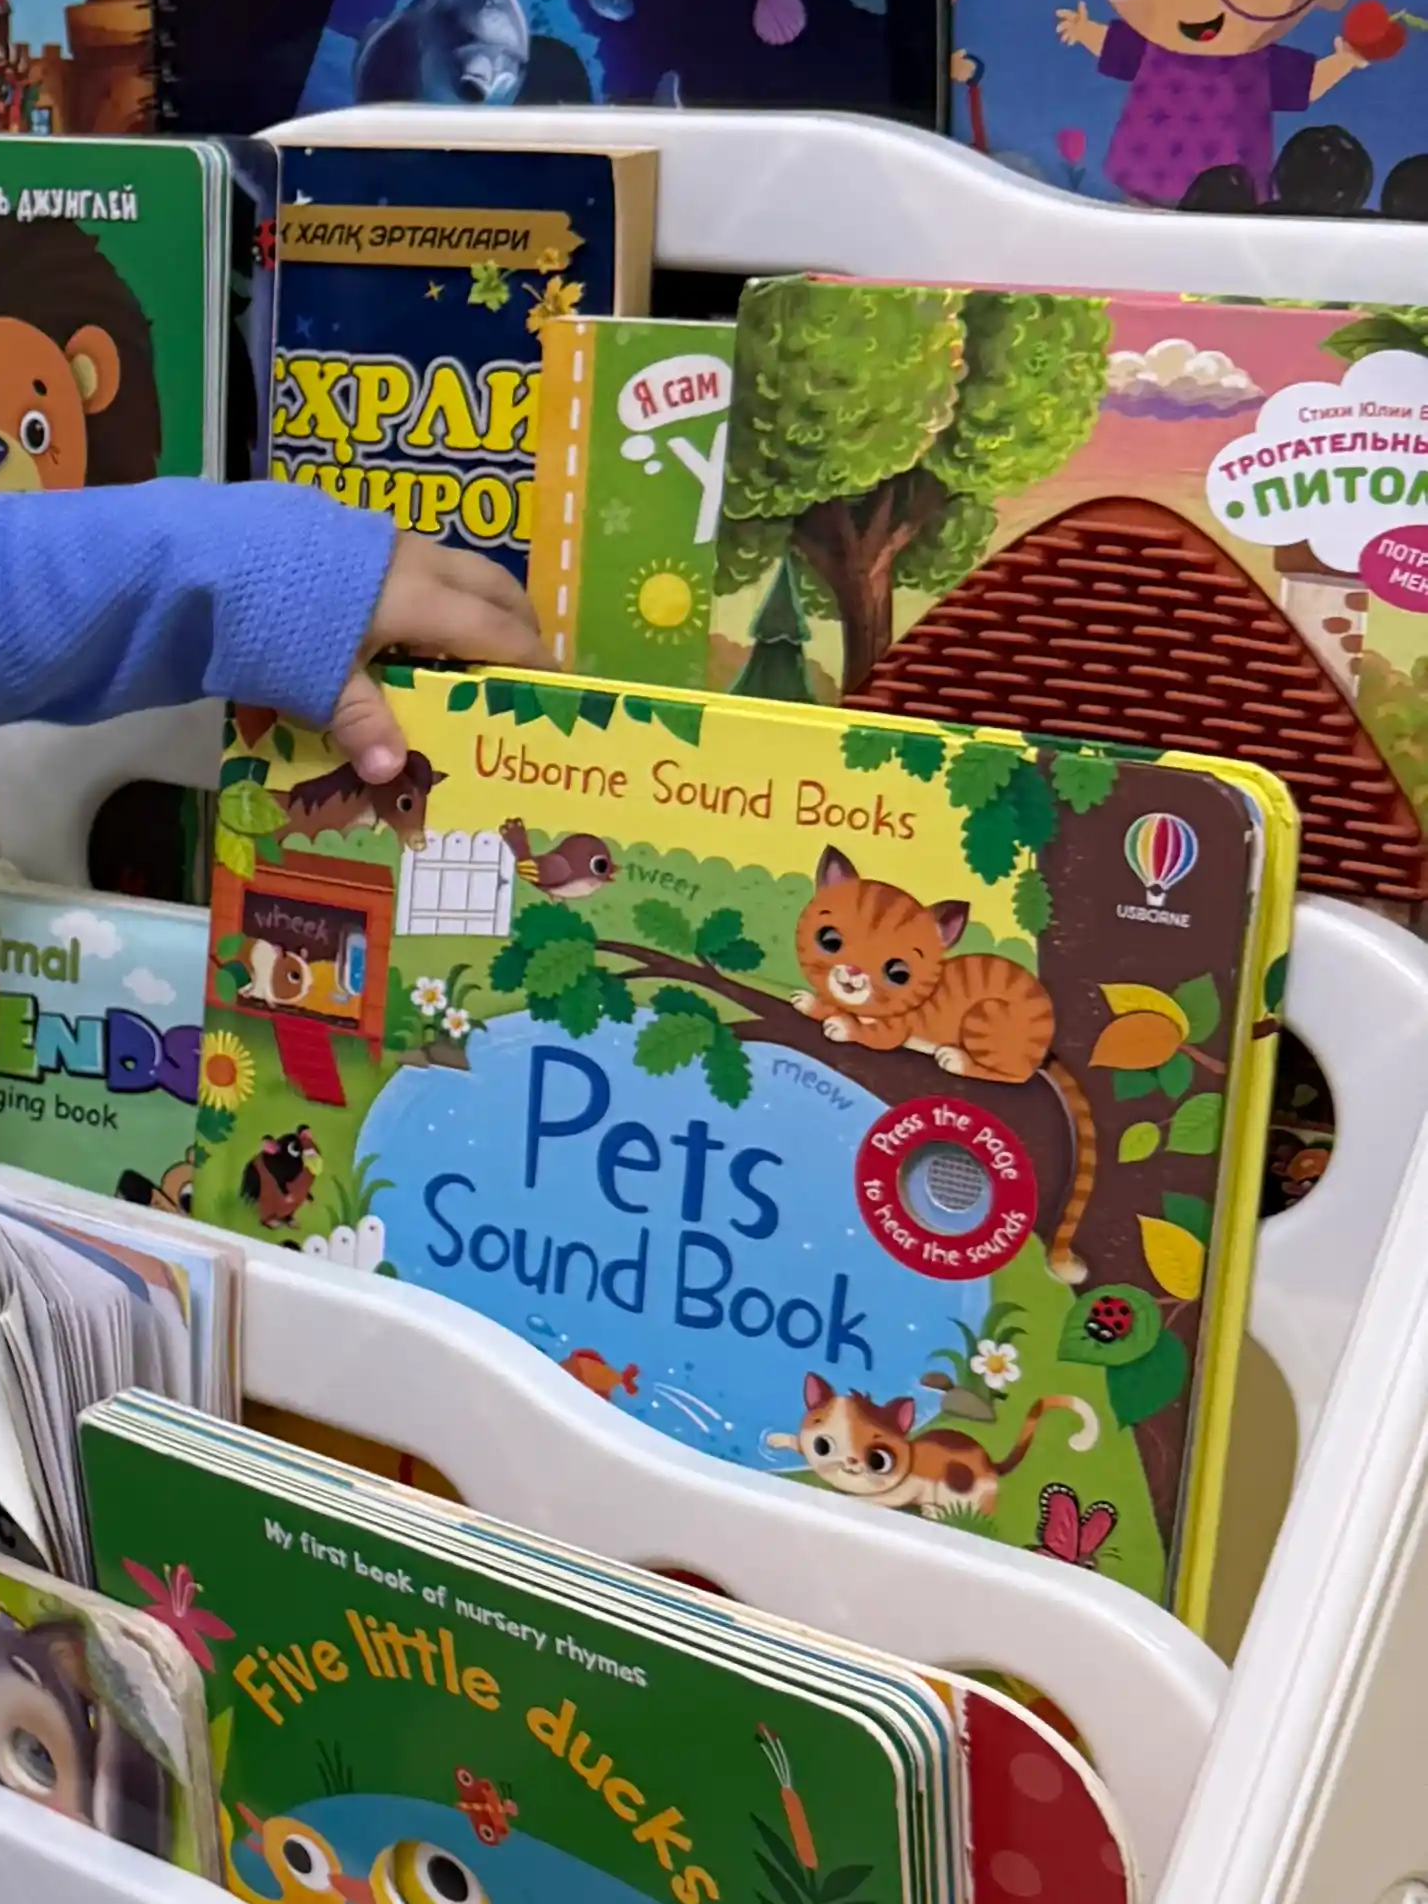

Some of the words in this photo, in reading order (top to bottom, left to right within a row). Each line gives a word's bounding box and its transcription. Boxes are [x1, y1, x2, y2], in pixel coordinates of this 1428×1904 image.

[16, 183, 139, 224] ДЖУНГЛЕЙ
[295, 222, 365, 252] ХАЛҚ
[369, 225, 531, 252] ЭРТАКЛАРИ
[633, 379, 659, 419] Я
[662, 371, 720, 409] сам
[1298, 404, 1354, 424] Стихи
[1359, 400, 1413, 419] Юлии
[474, 734, 628, 798] Usborne
[651, 758, 773, 819] Sound
[795, 779, 918, 841] Books
[622, 861, 700, 901] tweet
[254, 903, 329, 945] wheek
[1116, 903, 1191, 928] USBORNE
[771, 1057, 855, 1111] meow
[55, 1093, 119, 1130] book
[524, 1044, 785, 1240] Pets
[871, 1112, 925, 1156] Press
[932, 1103, 971, 1132] the
[972, 1126, 1020, 1181] page
[863, 1178, 884, 1202] to
[874, 1203, 919, 1251] hear
[922, 1240, 961, 1266] the
[966, 1210, 1027, 1264] sounds
[423, 1172, 651, 1315] Sound
[674, 1229, 873, 1372] Book
[263, 1517, 294, 1550] My
[300, 1533, 348, 1570] first
[354, 1550, 415, 1595] book
[422, 1582, 448, 1609] of
[455, 1597, 547, 1652] nursery
[554, 1635, 649, 1689] rhymes
[232, 1637, 350, 1727] Five
[344, 1607, 502, 1711] little
